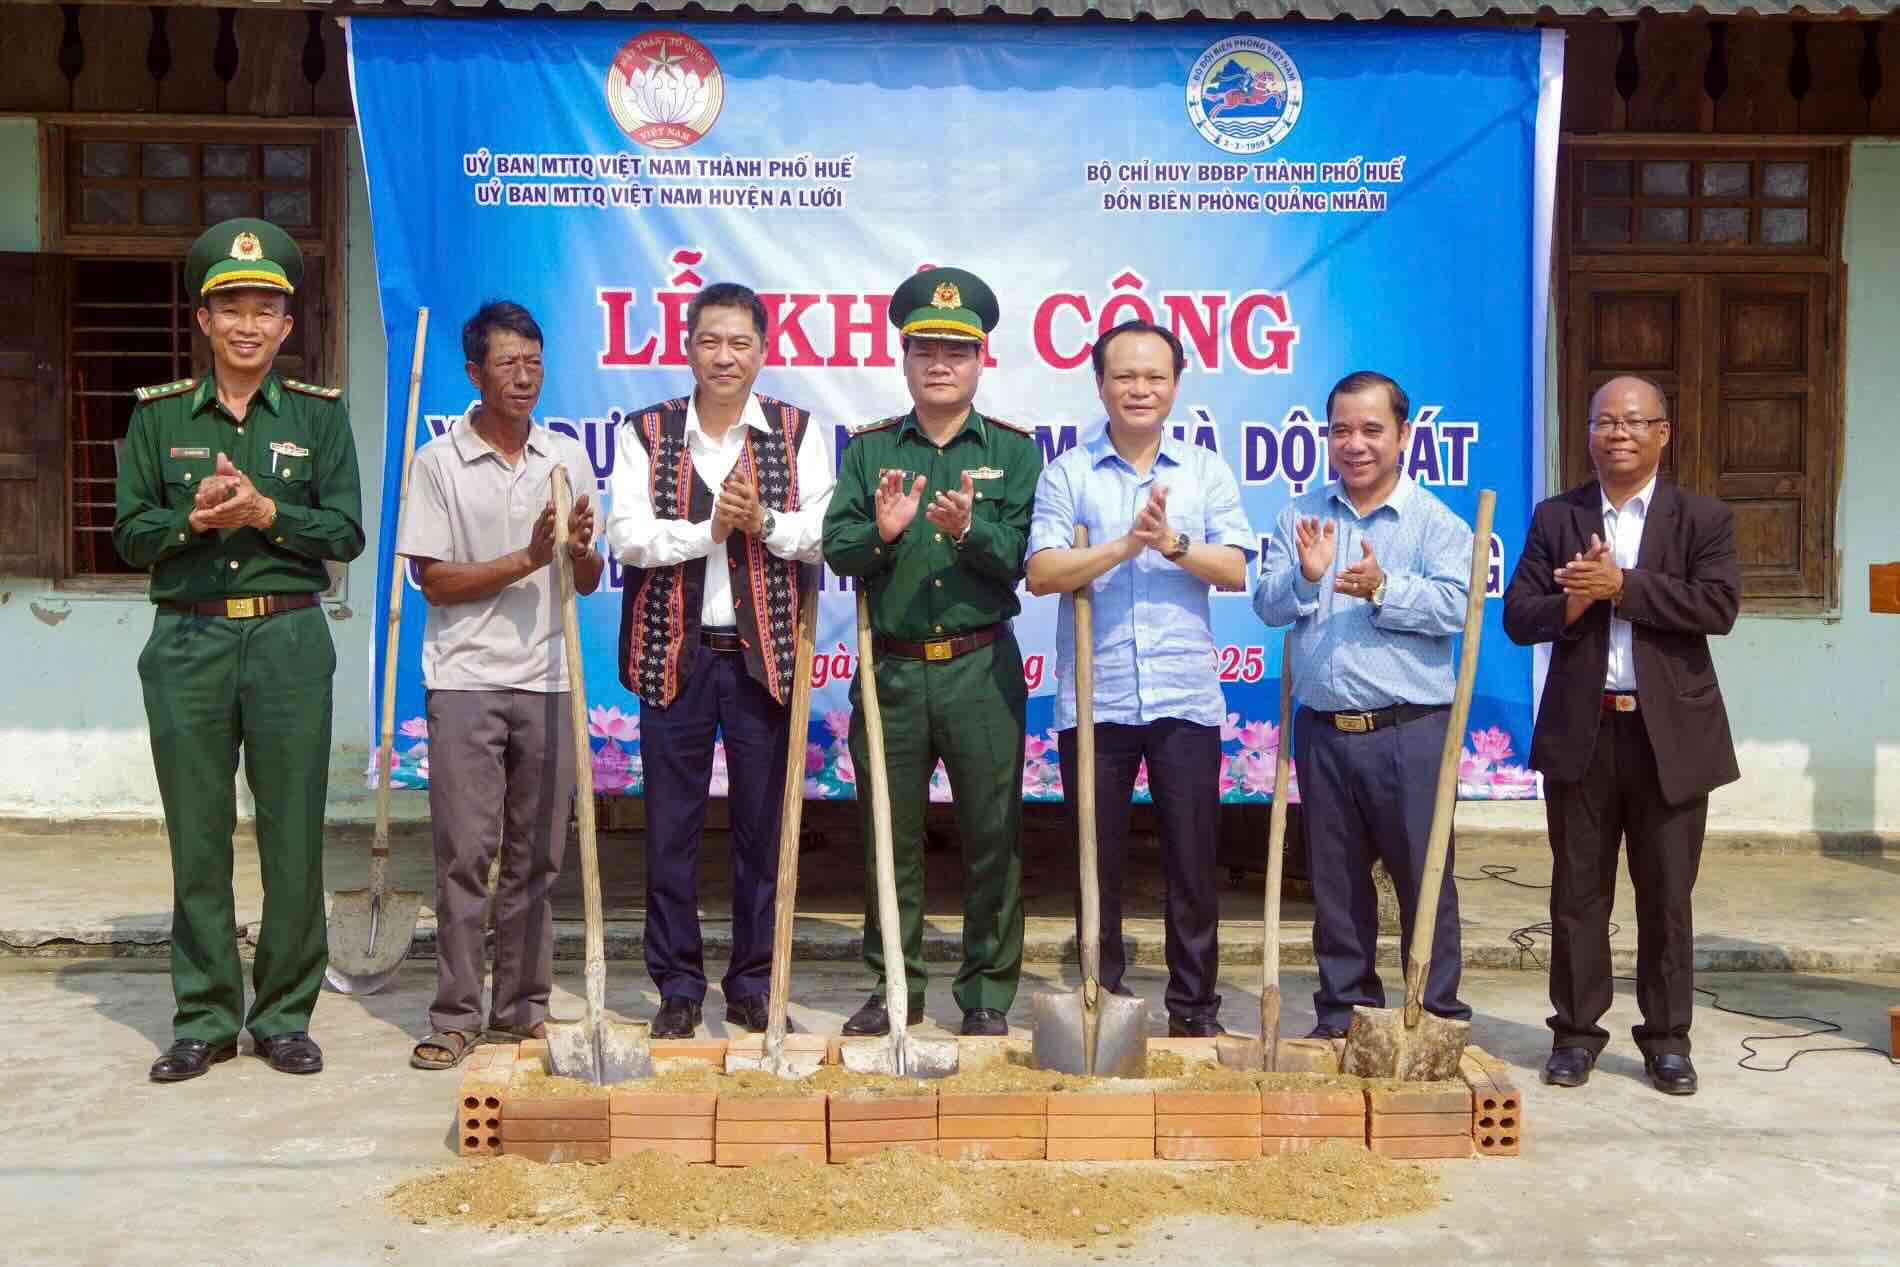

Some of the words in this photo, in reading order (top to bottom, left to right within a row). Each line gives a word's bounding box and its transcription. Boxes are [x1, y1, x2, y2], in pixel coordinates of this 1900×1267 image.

[465, 150, 489, 173] UỶ
[497, 156, 535, 174] BAN
[541, 156, 593, 176] MTTQ
[599, 154, 641, 178] VIỆT
[649, 158, 691, 176] NAM
[697, 155, 762, 177] THÀNH
[769, 155, 809, 178] PHỐ
[815, 155, 854, 178] HUẾ
[1087, 160, 1112, 184] BỘ
[1118, 159, 1150, 181] CHỈ
[1155, 165, 1191, 181] HUY
[1198, 165, 1249, 181] BĐBP
[1254, 160, 1315, 181] THÀNH
[1322, 157, 1361, 181] PHỐ
[1366, 157, 1405, 181] HUẾ
[478, 180, 501, 203] UỶ
[509, 186, 546, 203] BAN
[553, 187, 605, 207] MTTQ
[610, 184, 653, 207] VIỆT
[660, 188, 702, 205] NAM
[709, 185, 773, 209] HUYỆN
[779, 190, 792, 207] A
[799, 186, 843, 207] LƯỚI
[1103, 186, 1142, 210] ĐỒN
[1148, 190, 1191, 210] BIÊN
[1198, 190, 1259, 210] PHÒNG
[1265, 188, 1326, 212] QUẢNG
[1332, 189, 1385, 210] NHÂM
[1398, 410, 1474, 481] ÁT
